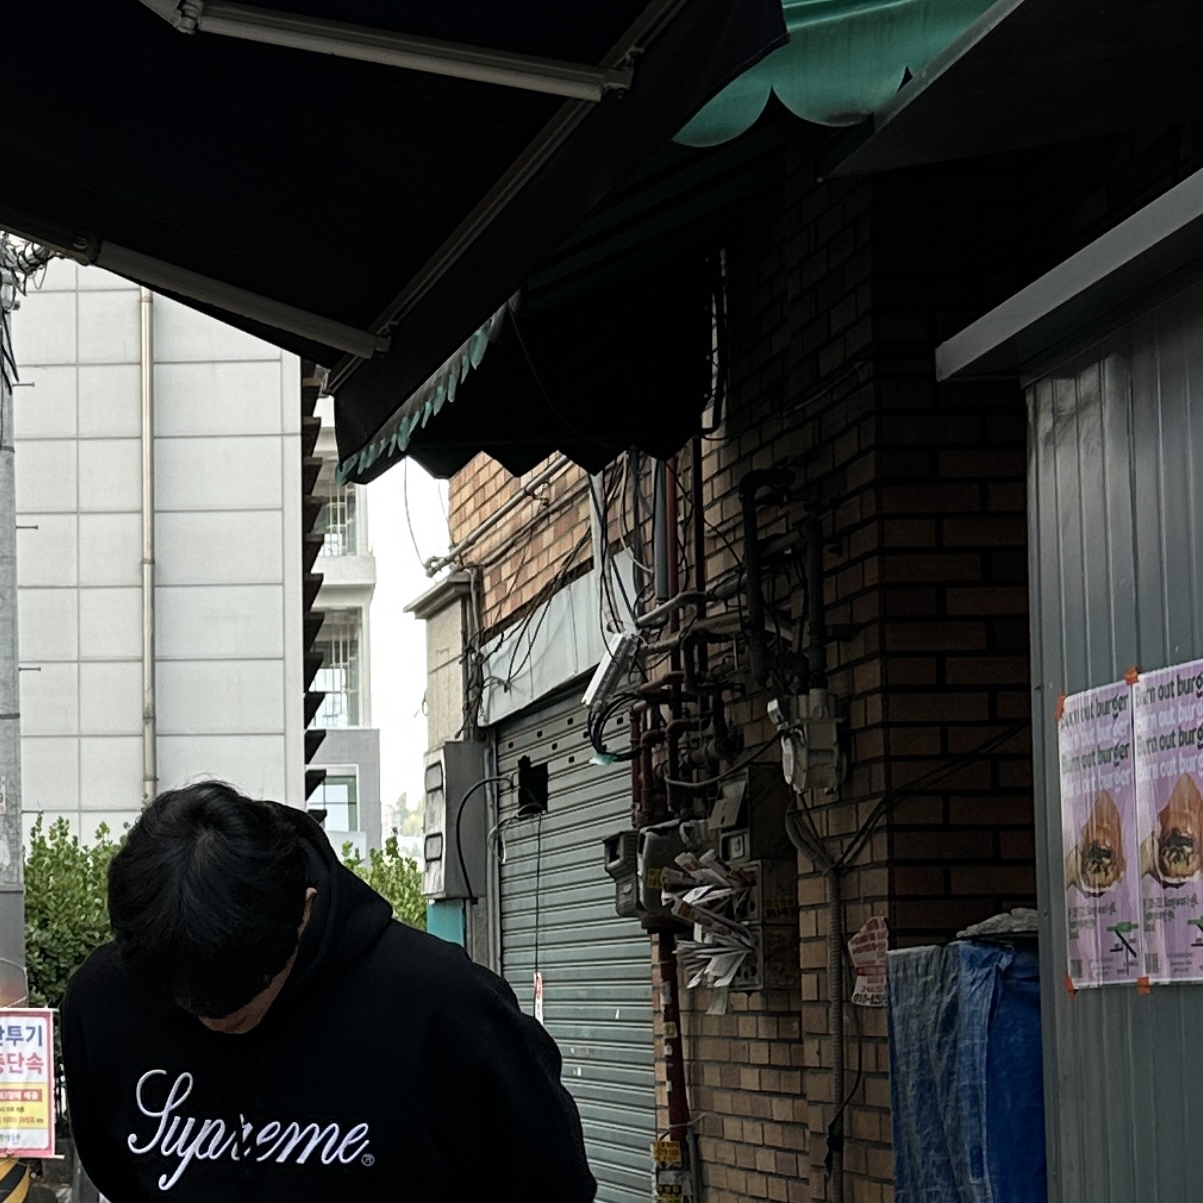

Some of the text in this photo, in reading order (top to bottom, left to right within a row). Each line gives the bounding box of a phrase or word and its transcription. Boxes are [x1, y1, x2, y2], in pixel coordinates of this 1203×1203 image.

[1158, 679, 1175, 701] out
[1080, 703, 1094, 722] out
[1096, 694, 1129, 720] burger
[1159, 707, 1176, 727] out
[1159, 729, 1176, 751] out
[1097, 742, 1130, 768] burger
[1160, 757, 1177, 777] out
